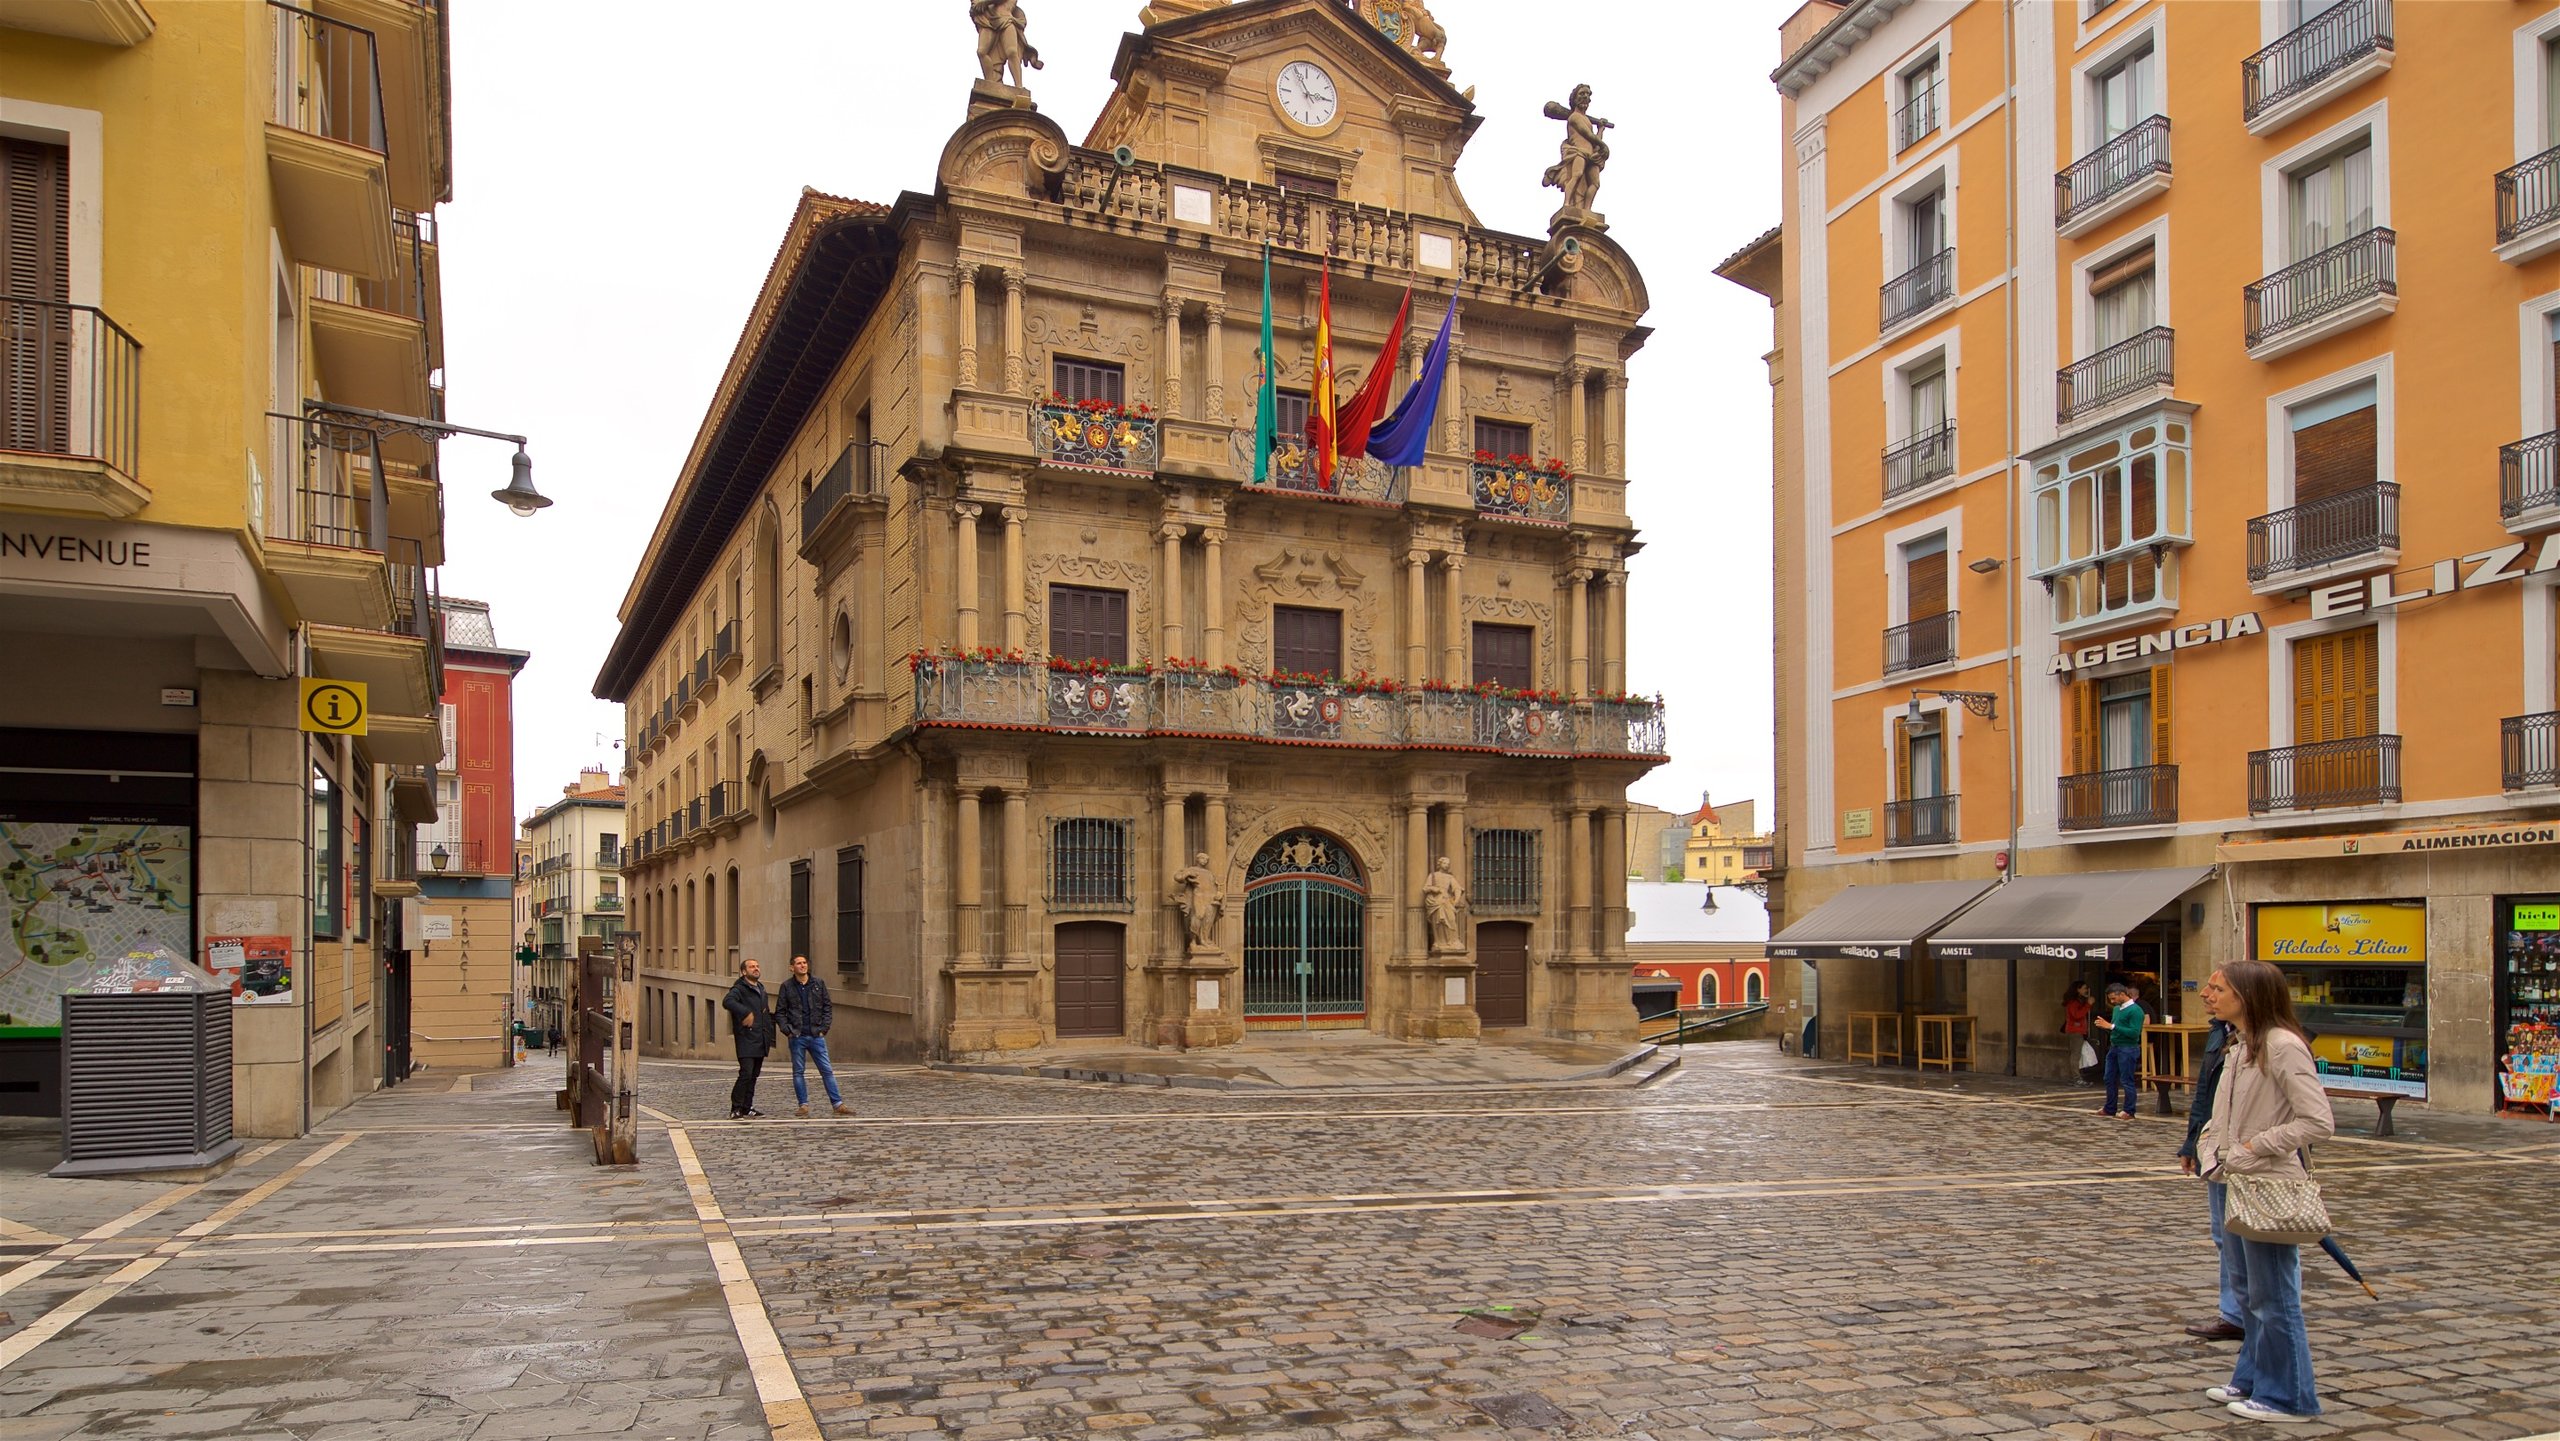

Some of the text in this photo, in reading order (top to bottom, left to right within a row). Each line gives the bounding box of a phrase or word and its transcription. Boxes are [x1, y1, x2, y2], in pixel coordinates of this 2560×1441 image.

[2, 532, 150, 568] NVENUE
[2045, 611, 2266, 676] AGENCIA
[2402, 827, 2555, 851] ALIMENTACIÓN
[2518, 911, 2556, 919] hielo
[459, 906, 470, 993] FARMACIA
[1773, 948, 1798, 956] AMSTEL
[1940, 947, 1973, 956] AMSTEL
[2273, 938, 2412, 955] Helados Lilian
